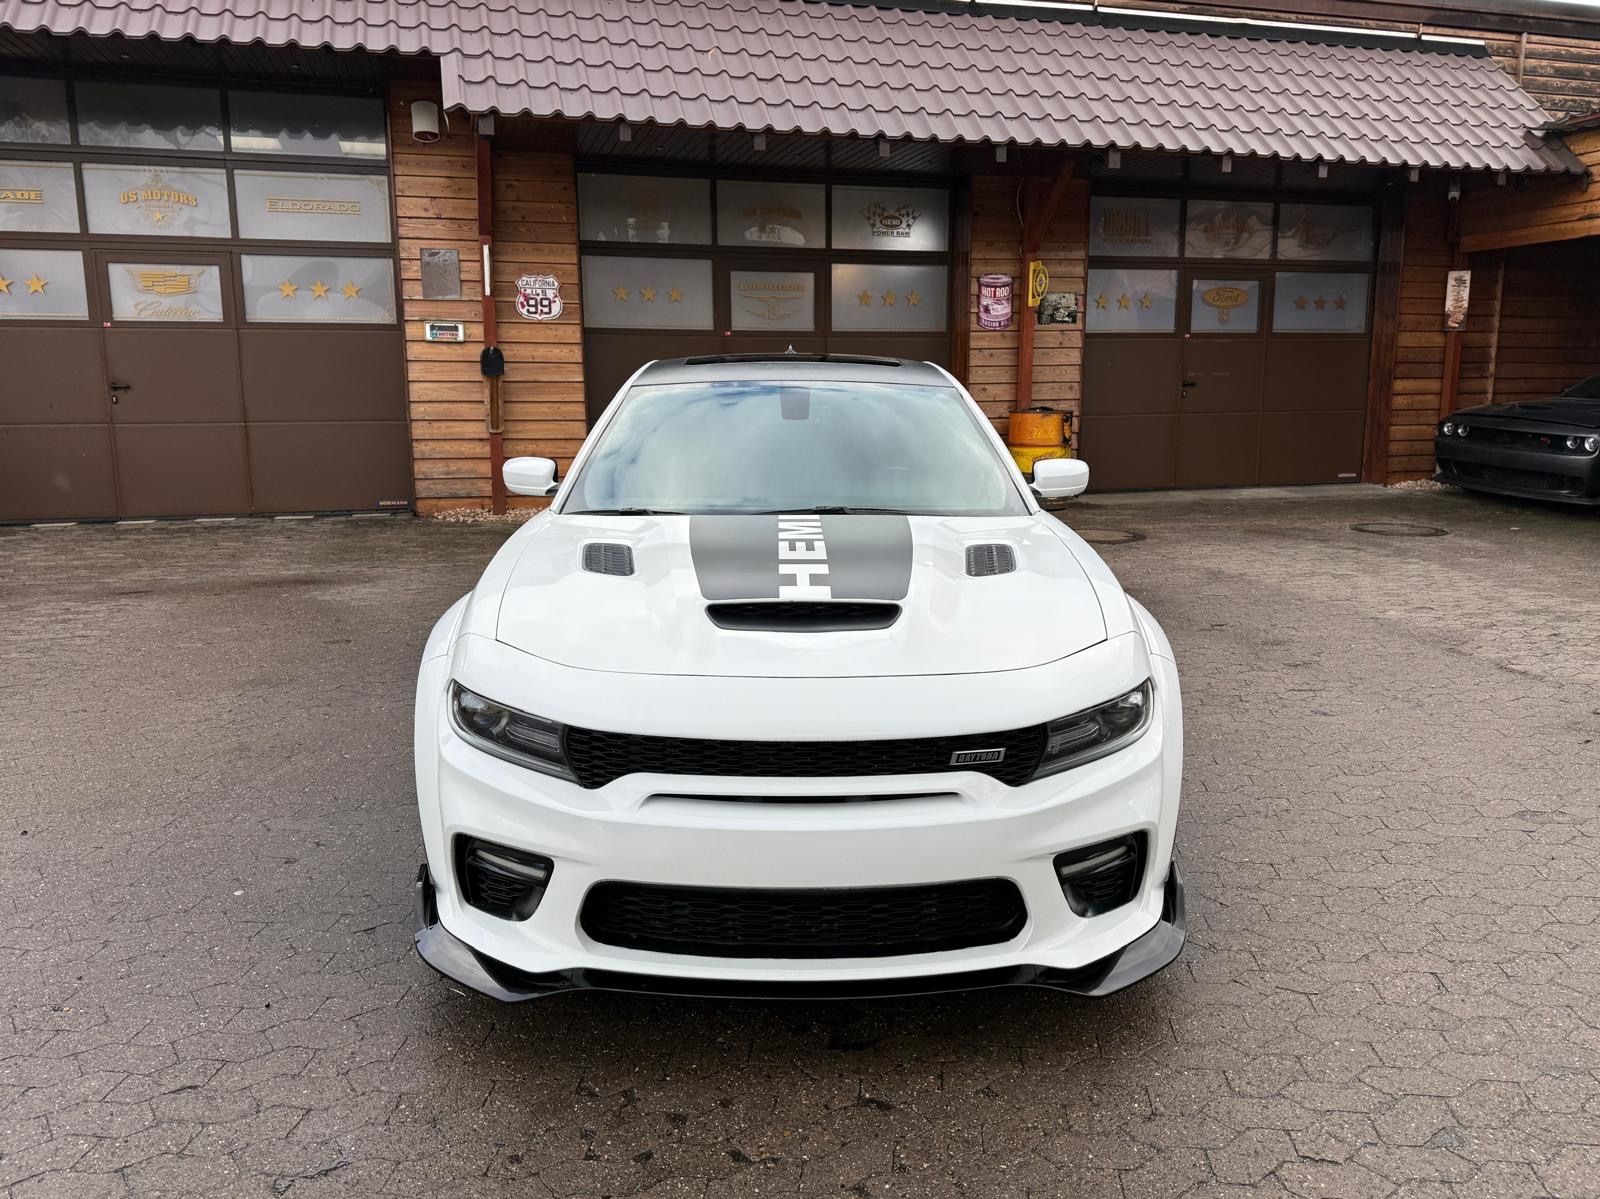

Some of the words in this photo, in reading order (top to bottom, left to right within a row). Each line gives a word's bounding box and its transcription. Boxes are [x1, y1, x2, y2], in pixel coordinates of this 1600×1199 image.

[120, 191, 137, 204] US
[142, 190, 198, 207] MOTORS
[266, 199, 360, 212] ELDORADO
[520, 279, 556, 288] CALIFORNIA
[981, 287, 995, 297] HOT
[996, 287, 1009, 297] ROD
[526, 297, 552, 314] 99
[958, 752, 999, 762] DAYTONA
